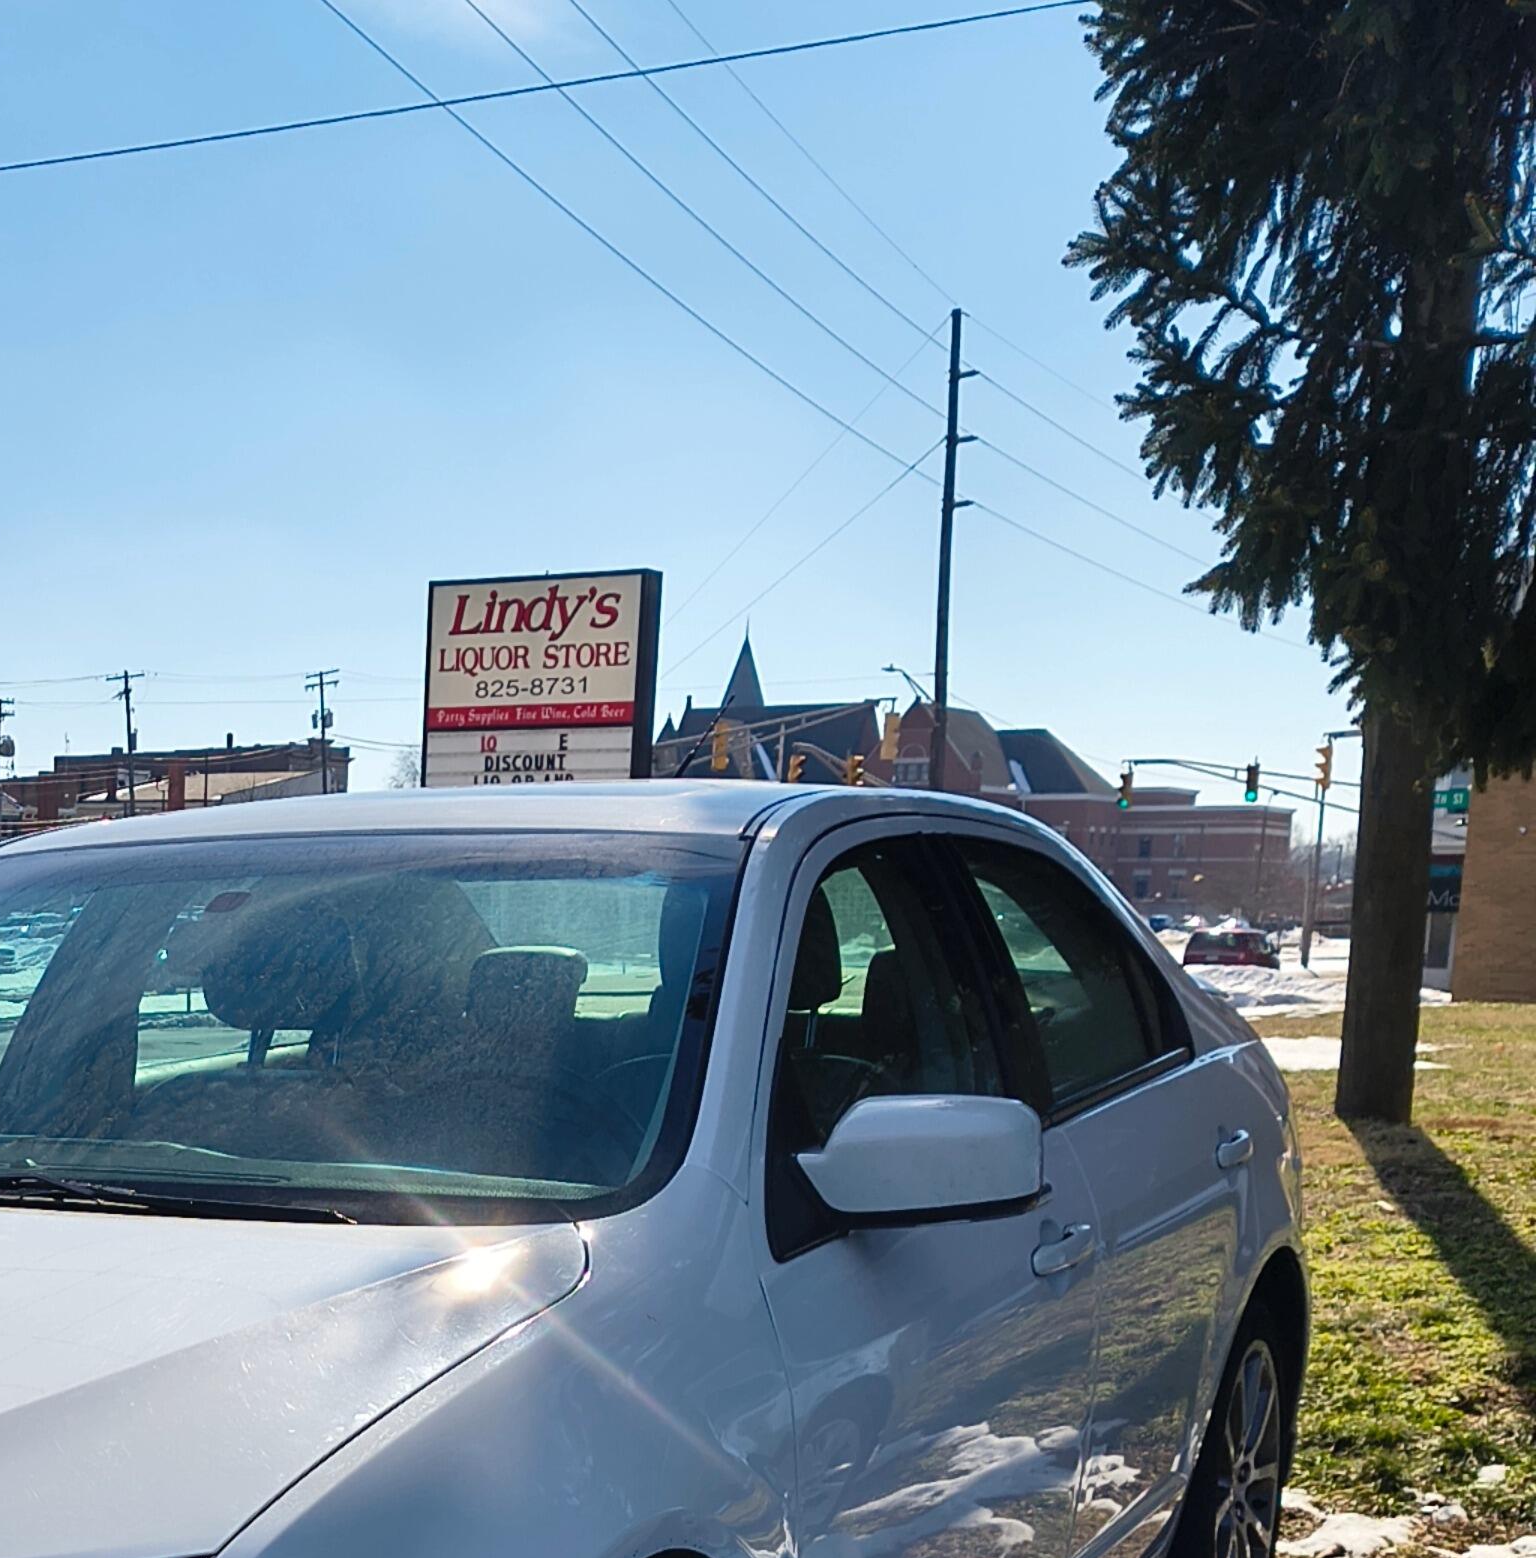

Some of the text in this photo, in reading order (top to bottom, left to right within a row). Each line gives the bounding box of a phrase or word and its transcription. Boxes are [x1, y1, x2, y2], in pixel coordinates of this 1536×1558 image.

[448, 584, 622, 642] Lindy's
[438, 641, 631, 677] LIQUOR STORE
[475, 676, 588, 699] 825-8731
[436, 709, 465, 727] Party
[468, 708, 509, 726] Supplies
[515, 706, 537, 720] Fine
[573, 705, 597, 719] Cold
[601, 704, 625, 718] Beer
[559, 733, 568, 751] E
[484, 753, 566, 772] DISCOUNT
